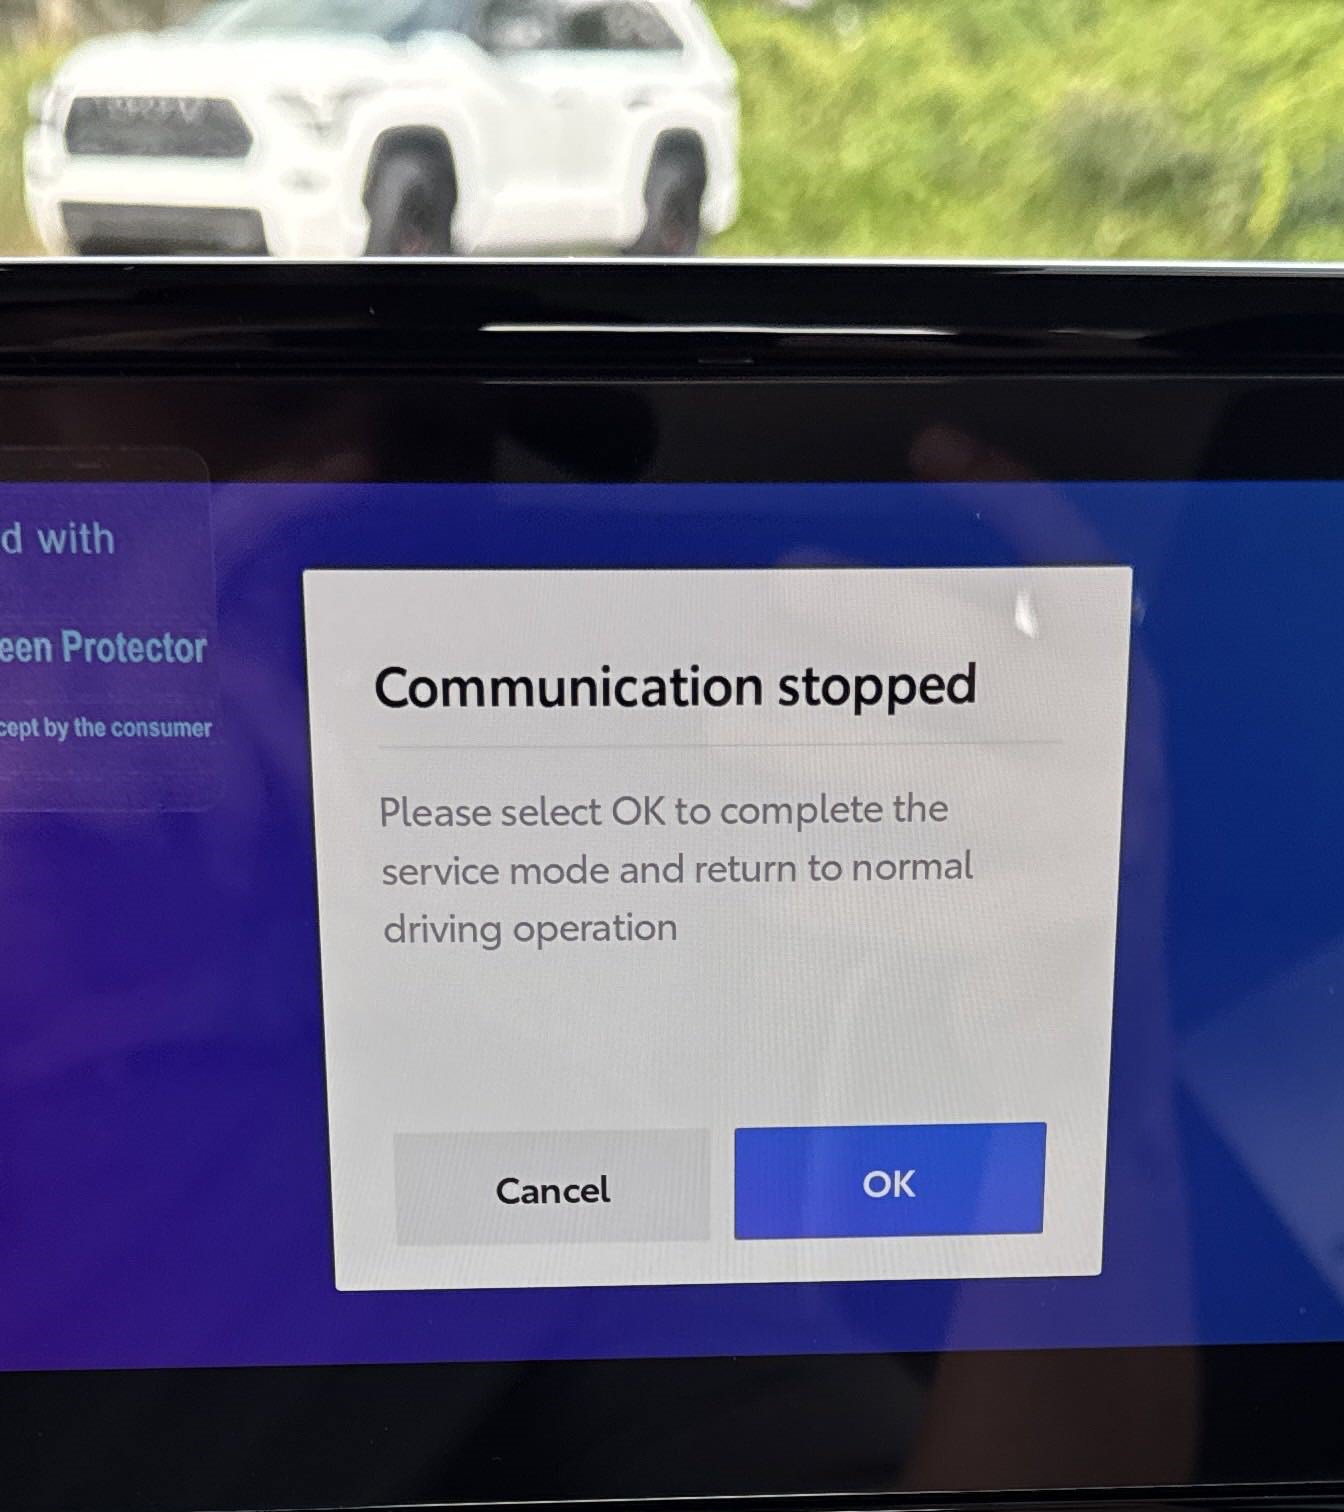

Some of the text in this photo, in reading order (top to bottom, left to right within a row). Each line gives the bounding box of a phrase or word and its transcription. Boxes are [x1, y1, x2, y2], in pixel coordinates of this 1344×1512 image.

[37, 521, 115, 555] with
[61, 629, 208, 664] Protector
[374, 662, 978, 716] Communication stopped
[44, 716, 69, 743] by
[74, 716, 106, 738] the
[110, 719, 212, 738] consumer
[379, 792, 950, 834] Please select OK to complete the
[381, 849, 974, 887] service mode and return to normal
[383, 911, 679, 952] driving operation
[495, 1174, 612, 1206] Cancel
[862, 1170, 917, 1200] OK
